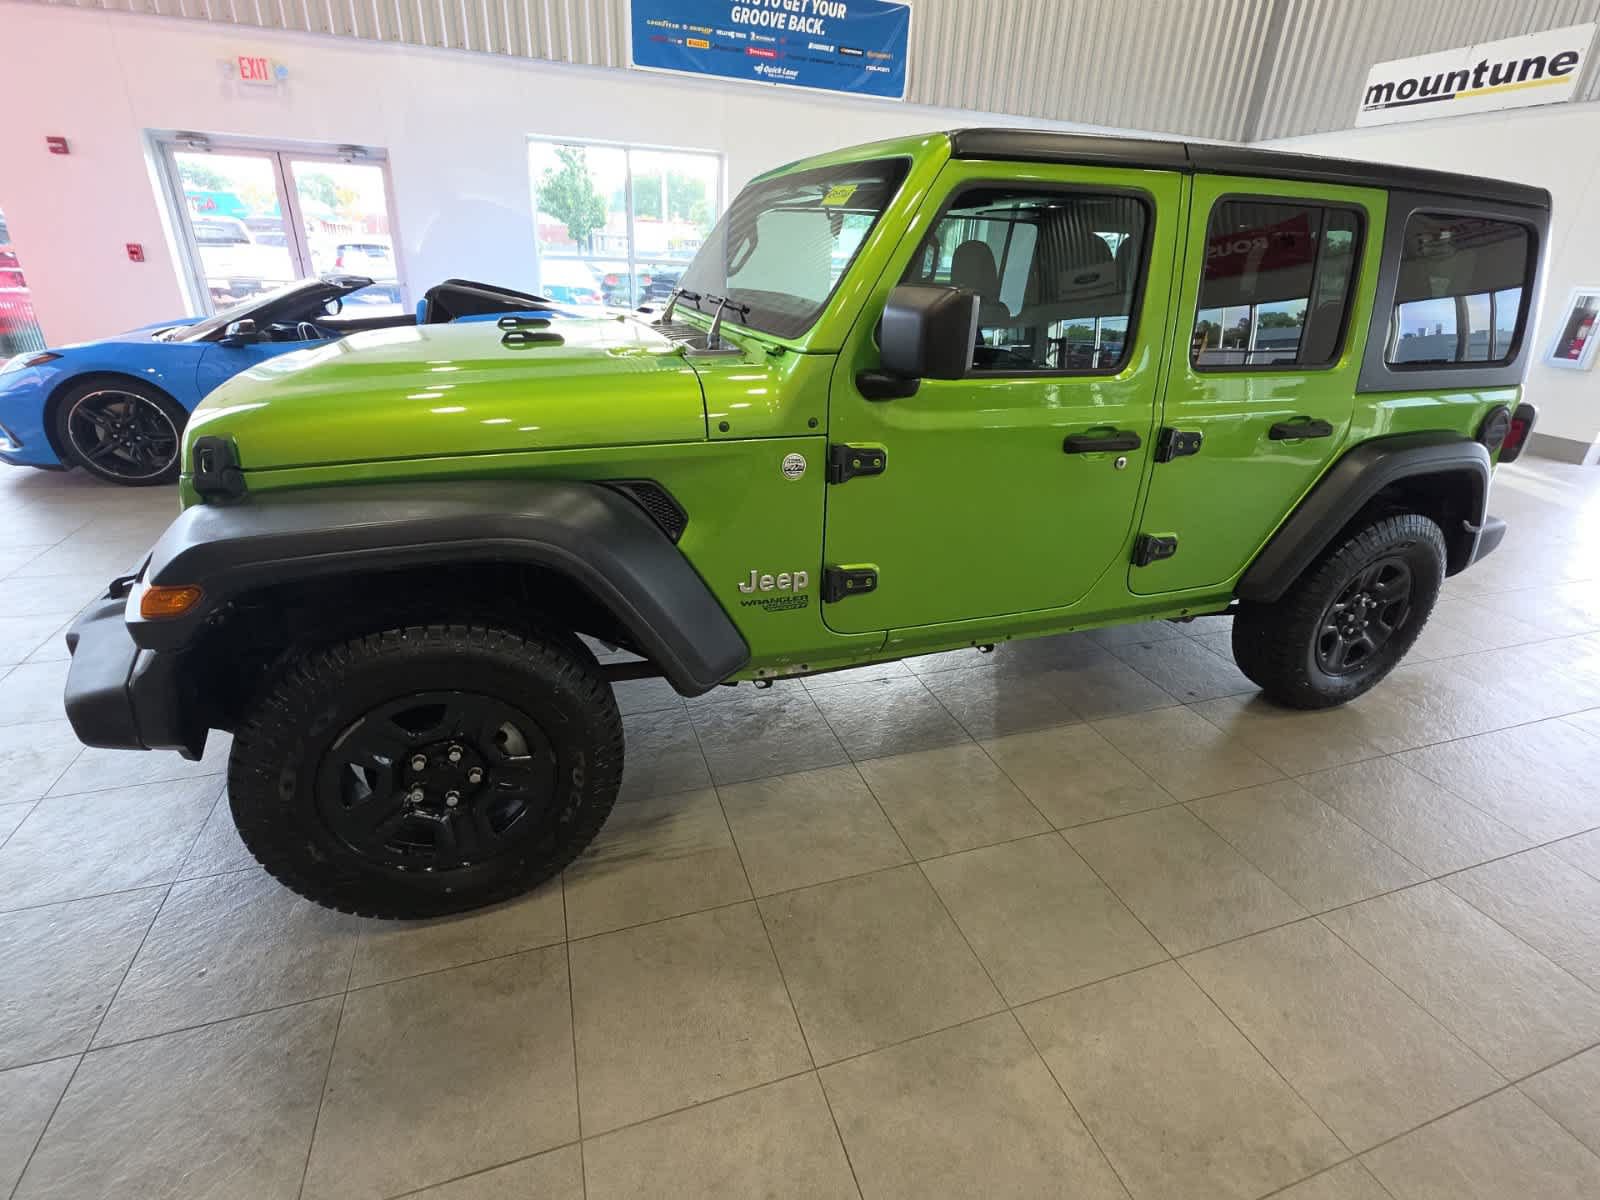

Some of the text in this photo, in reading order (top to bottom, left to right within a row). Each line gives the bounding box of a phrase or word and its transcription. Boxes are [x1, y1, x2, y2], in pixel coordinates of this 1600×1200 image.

[731, 6, 825, 35] GROOVE BACK.
[812, 0, 847, 19] YOUR
[238, 56, 269, 80] EXIT
[763, 65, 782, 75] Quick
[782, 67, 799, 77] Lane
[1363, 51, 1579, 105] mountune
[738, 569, 808, 593] Jeep
